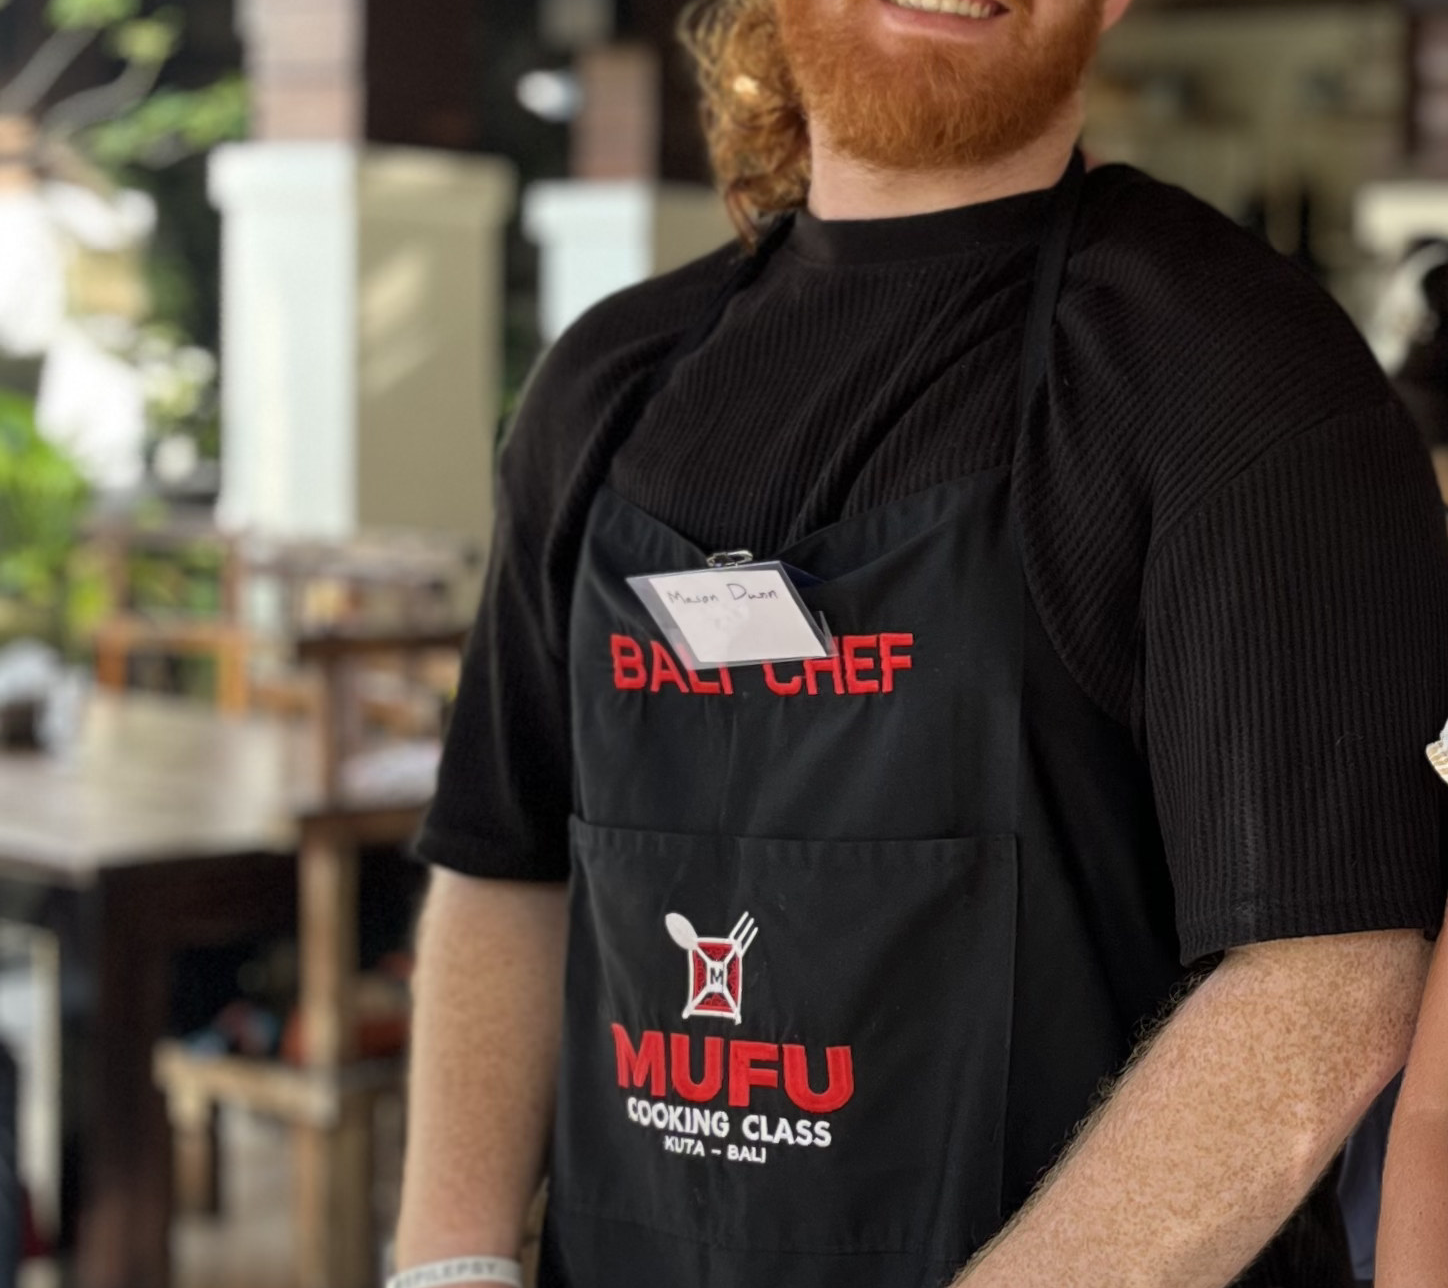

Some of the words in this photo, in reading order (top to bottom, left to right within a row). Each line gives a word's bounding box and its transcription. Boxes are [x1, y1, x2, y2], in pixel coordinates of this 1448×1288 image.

[610, 633, 734, 695] BALI
[763, 632, 914, 696] CHEF
[611, 1022, 855, 1114] MUFU
[626, 1096, 730, 1138] COOKING
[742, 1114, 832, 1147] CLASS
[663, 1134, 706, 1157] KUTA
[727, 1144, 766, 1163] BALI
